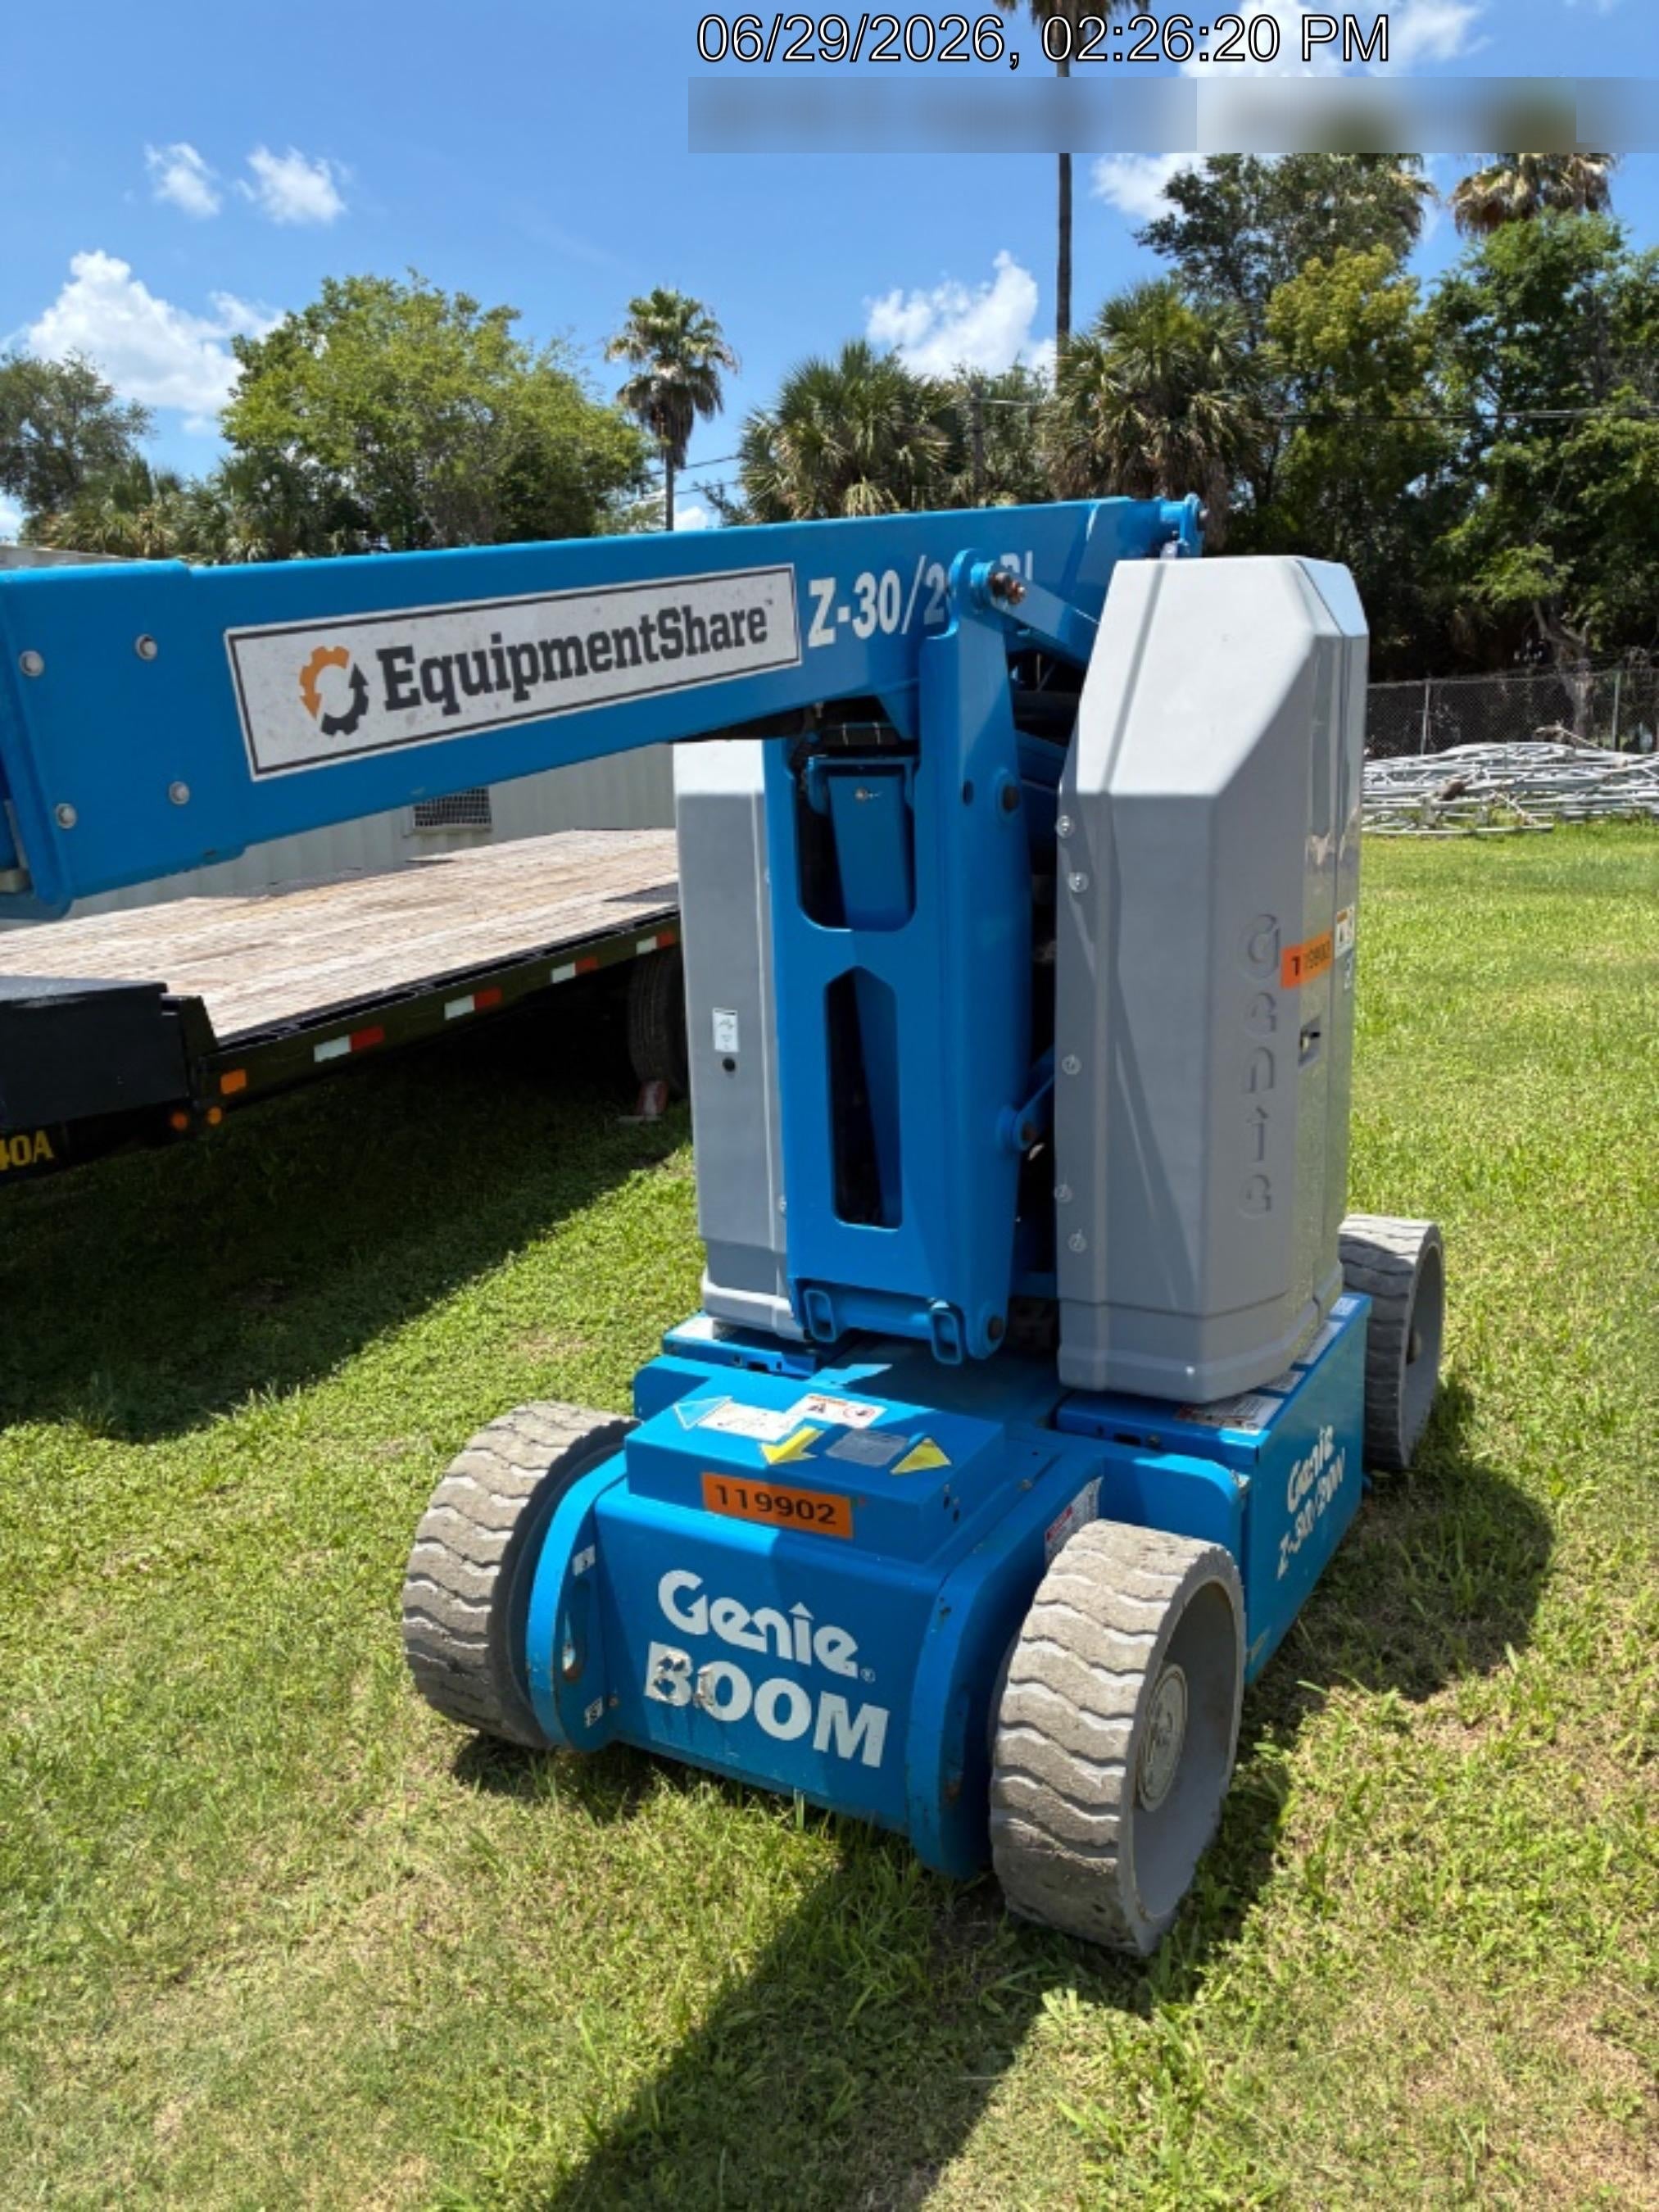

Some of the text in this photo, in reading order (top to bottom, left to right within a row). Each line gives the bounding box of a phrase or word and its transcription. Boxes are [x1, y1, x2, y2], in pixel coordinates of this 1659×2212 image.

[808, 555, 945, 648] Z-30/2
[378, 605, 768, 715] EquipmentShare
[714, 1484, 837, 1525] 119902
[658, 1569, 860, 1679] Genie
[644, 1641, 891, 1769] BOOM
